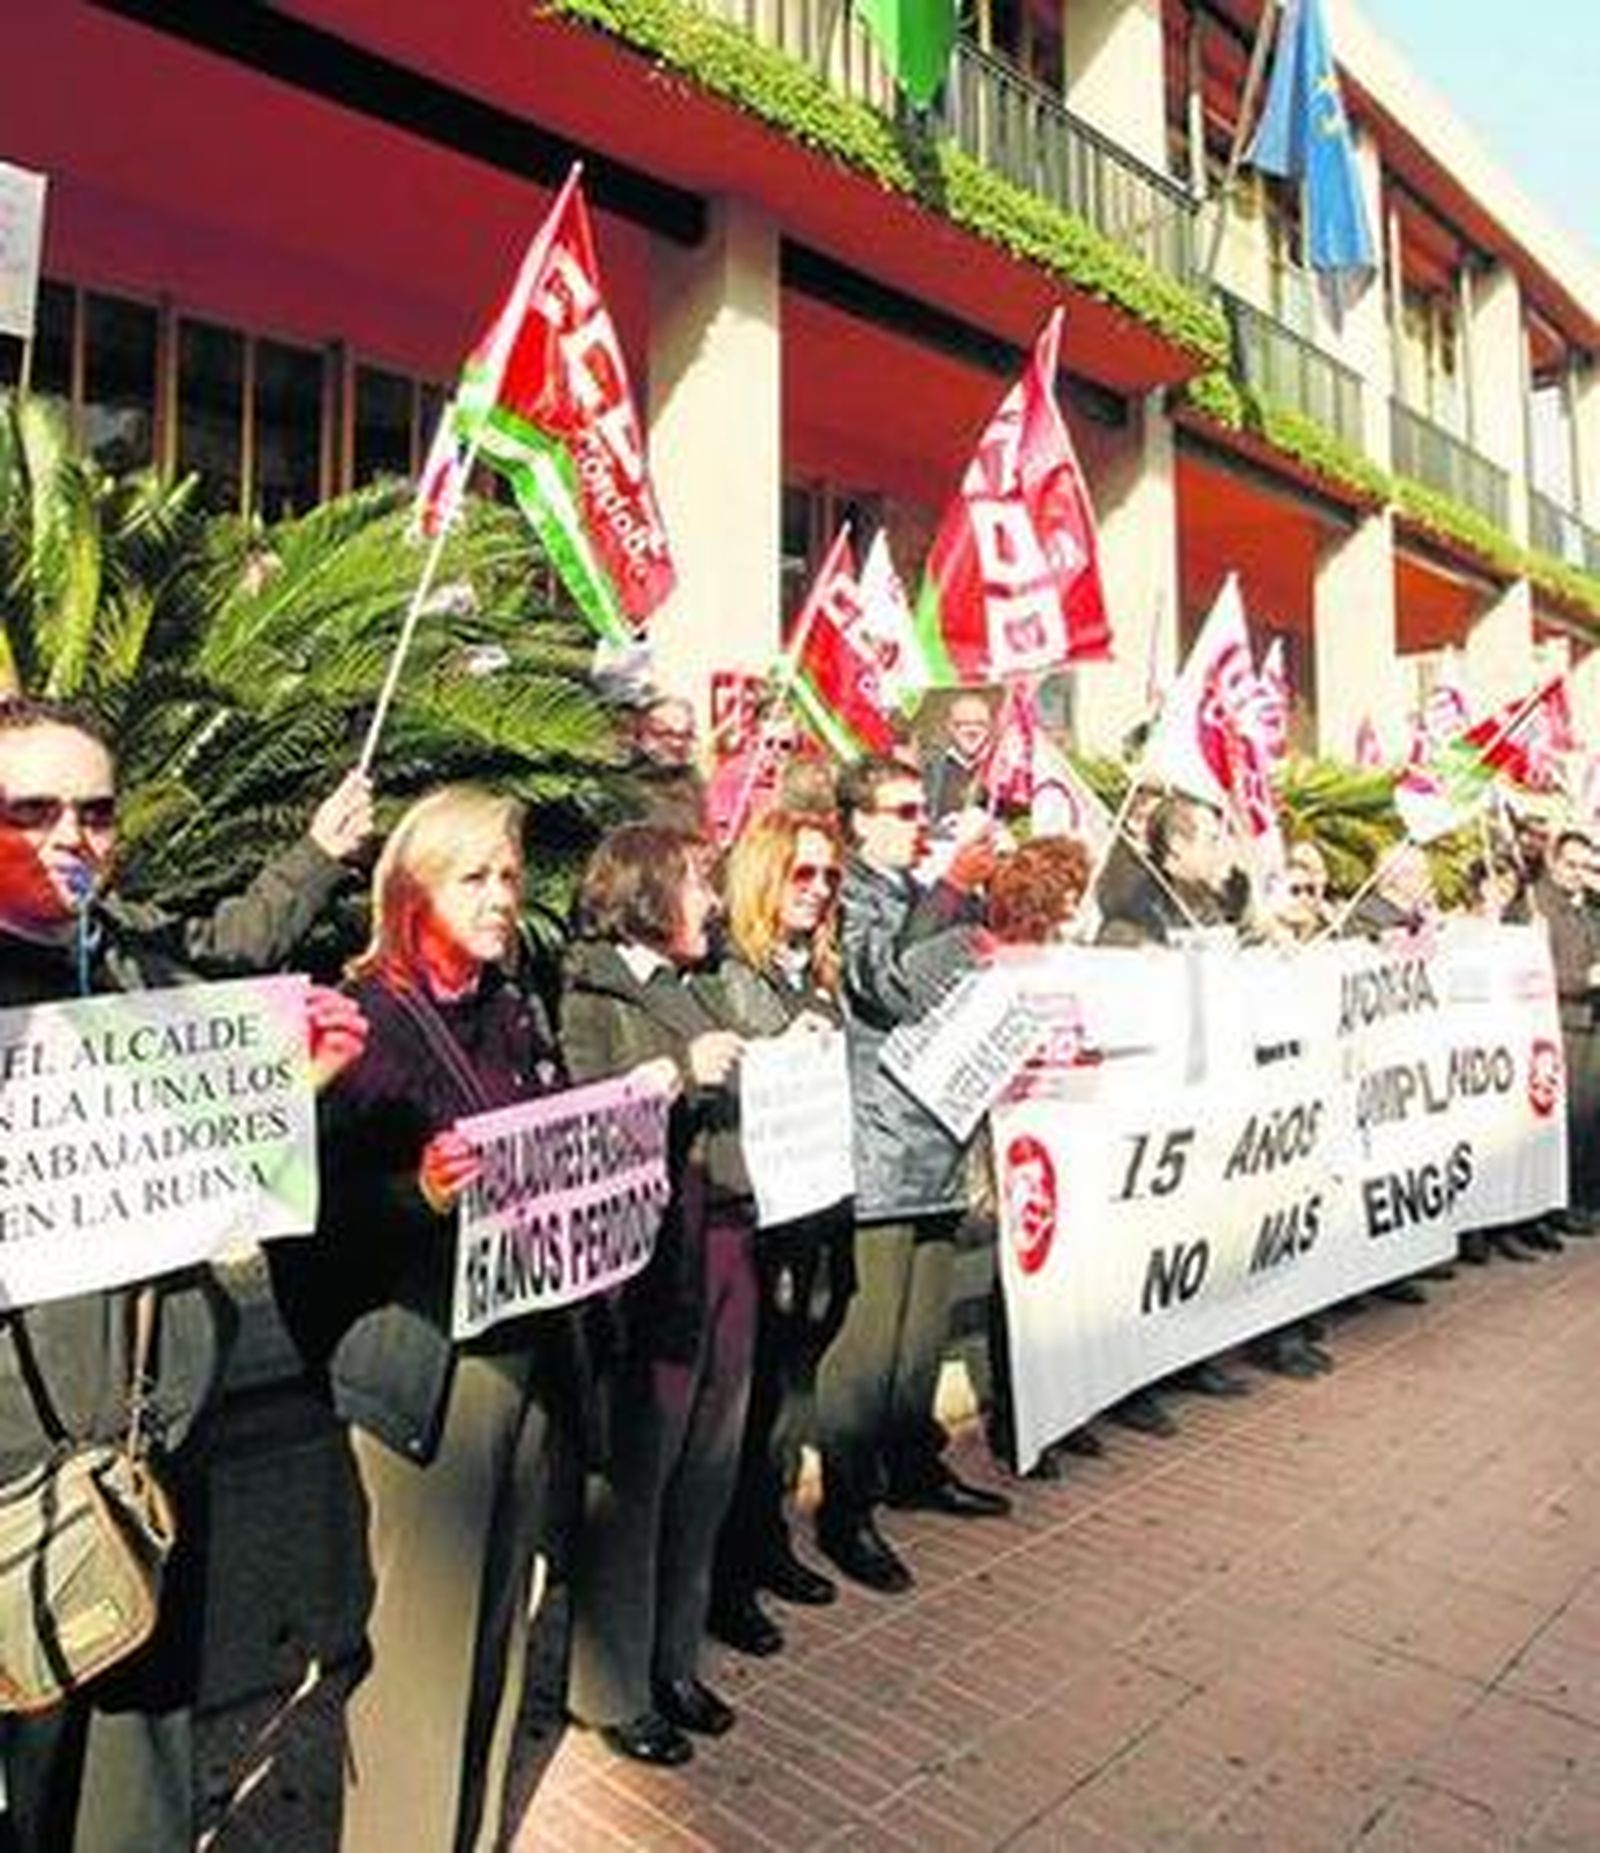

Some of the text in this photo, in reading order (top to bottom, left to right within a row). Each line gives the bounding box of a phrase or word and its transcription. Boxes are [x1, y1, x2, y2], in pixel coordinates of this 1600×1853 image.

[71, 1013, 260, 1071] ALCALDE
[226, 1058, 295, 1098] LOS
[72, 1188, 130, 1230] LA
[142, 1160, 270, 1214] RUINA
[1109, 1127, 1197, 1202] 15
[1141, 1238, 1209, 1315] NO
